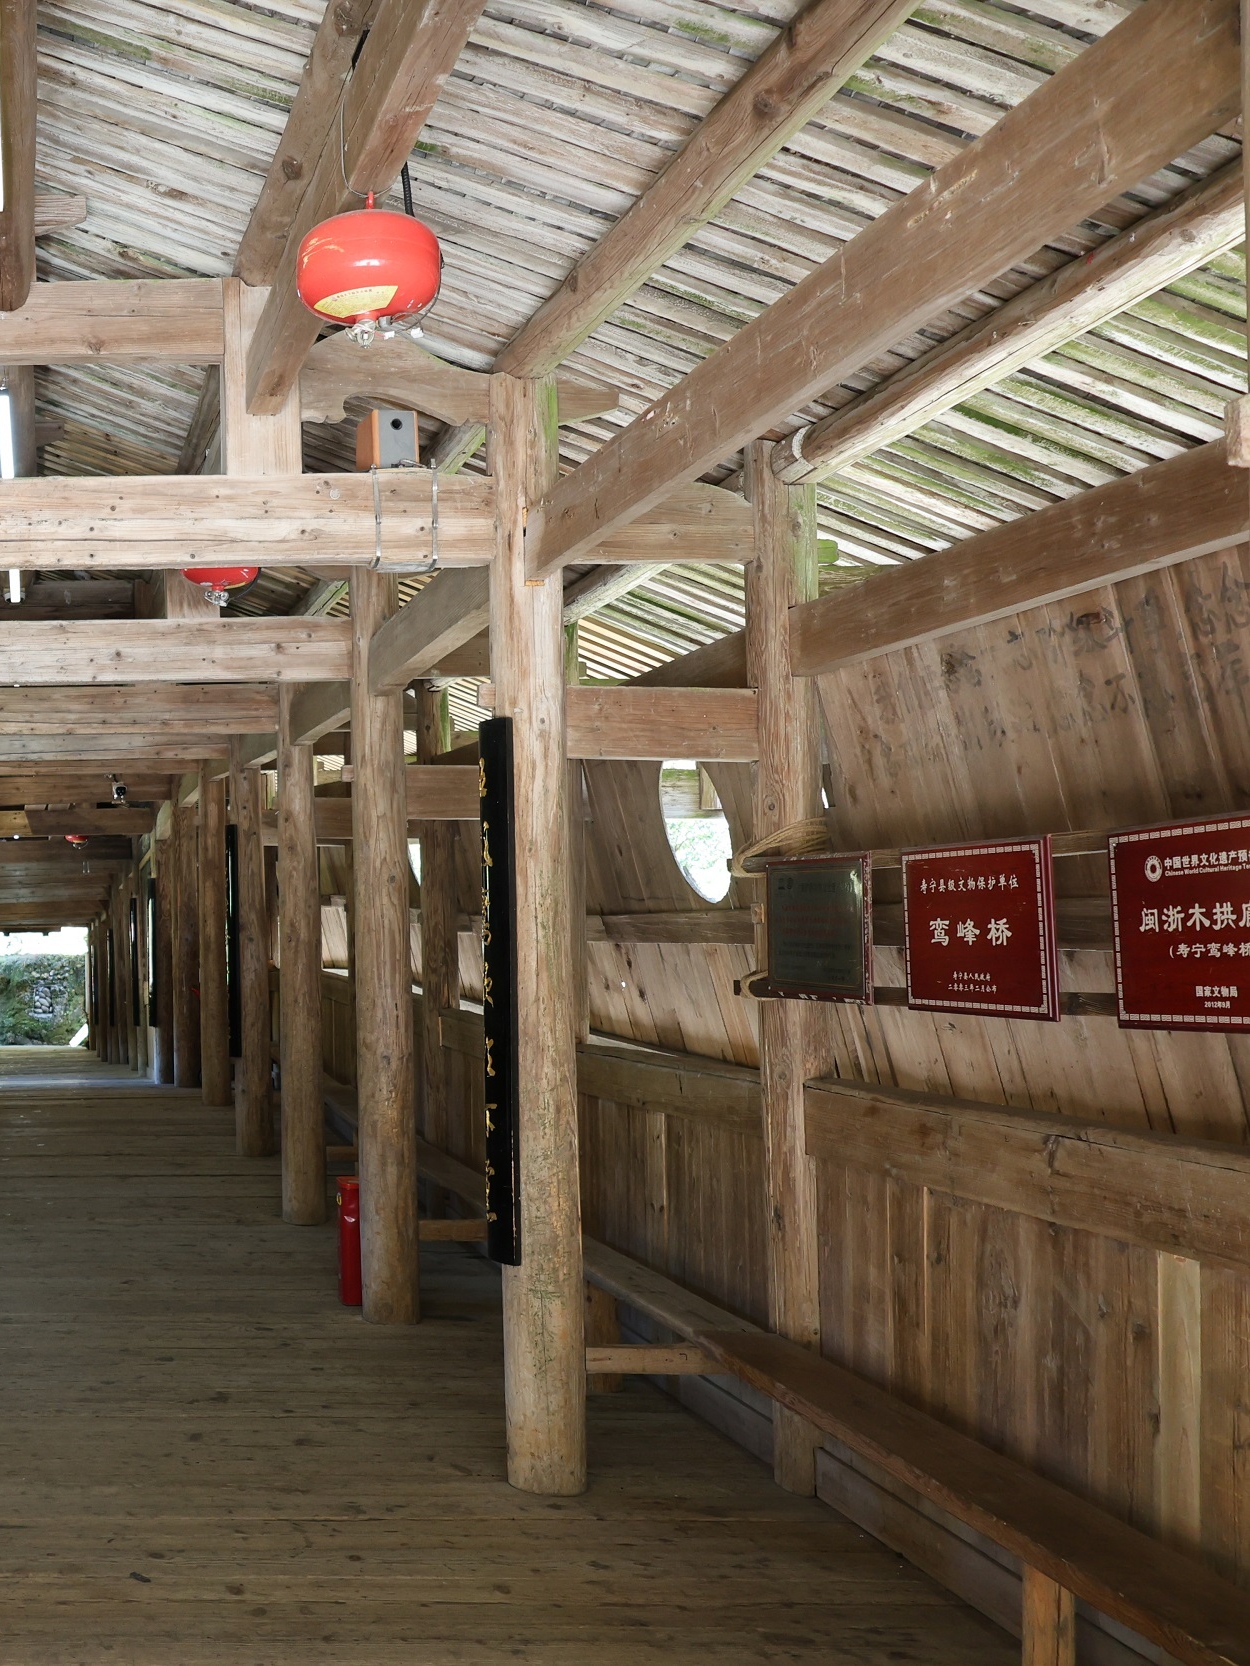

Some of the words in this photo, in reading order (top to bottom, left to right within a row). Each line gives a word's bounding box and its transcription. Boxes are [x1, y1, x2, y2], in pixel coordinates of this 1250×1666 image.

[1164, 849, 1250, 870] 中国世界文化遗产预
[920, 874, 1019, 894] 寿宁县级文物保护单位
[929, 918, 1012, 946] 鸾峰桥
[953, 971, 991, 982] 寿宁县人民政府
[1195, 986, 1238, 998] 国家文物局
[1204, 1001, 1231, 1009] 2012年9月
